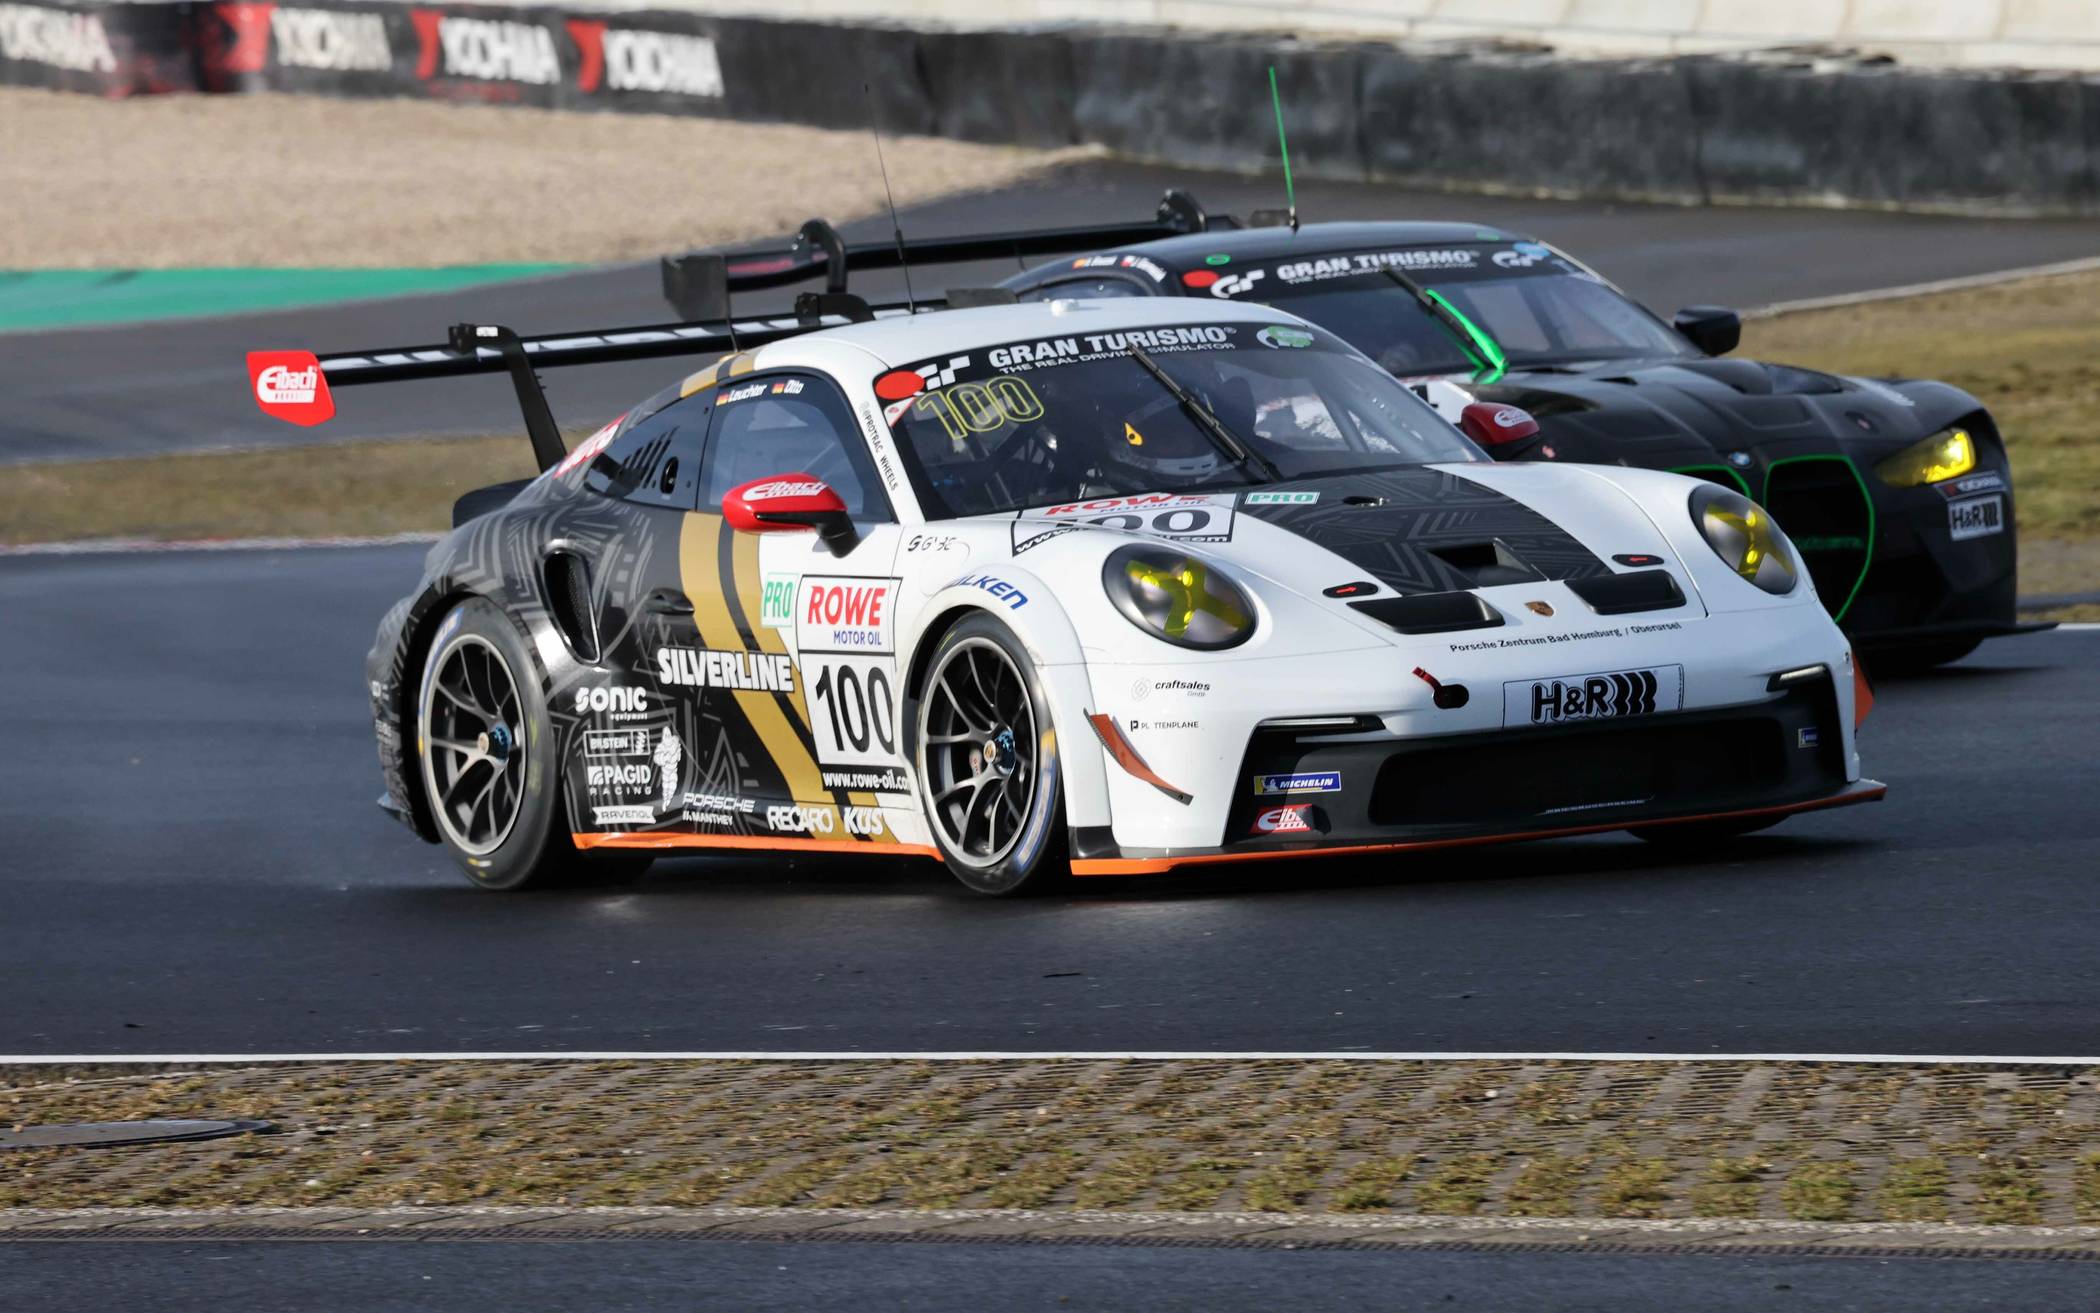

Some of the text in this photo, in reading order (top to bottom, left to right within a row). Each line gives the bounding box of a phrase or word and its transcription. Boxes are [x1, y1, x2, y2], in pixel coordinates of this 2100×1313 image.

[1277, 257, 1351, 280] GRAN
[989, 338, 1079, 367] GRAN
[999, 343, 1235, 374] THE REAL DRIVIN SIMULATOR
[916, 376, 1044, 440] 100
[880, 455, 899, 491] WHEELS
[1251, 494, 1313, 502] PRO
[763, 582, 794, 618] PRO
[808, 585, 887, 627] ROWE
[950, 575, 1028, 610] LKEN
[833, 630, 882, 645] MOTOR OIL
[1450, 641, 1497, 652] Porsche
[1500, 637, 1547, 648] Zentrum
[1549, 633, 1570, 644] Bad
[1572, 628, 1622, 640] Homburg
[1632, 622, 1682, 635] Oberursel
[657, 648, 795, 692] SILVERLINE
[1155, 680, 1210, 690] craftsales
[1531, 674, 1614, 722] H&R
[815, 664, 896, 755] 100
[1141, 721, 1199, 729] PLTTENPLANE
[591, 737, 628, 750] BILSTEIN
[604, 764, 651, 785] PAGID
[822, 769, 911, 791] www.rowe-oil.co
[1280, 778, 1333, 788] MICHELIN
[589, 786, 652, 795] RACING
[683, 792, 755, 813] PORSCHE
[766, 805, 834, 833] RECARO
